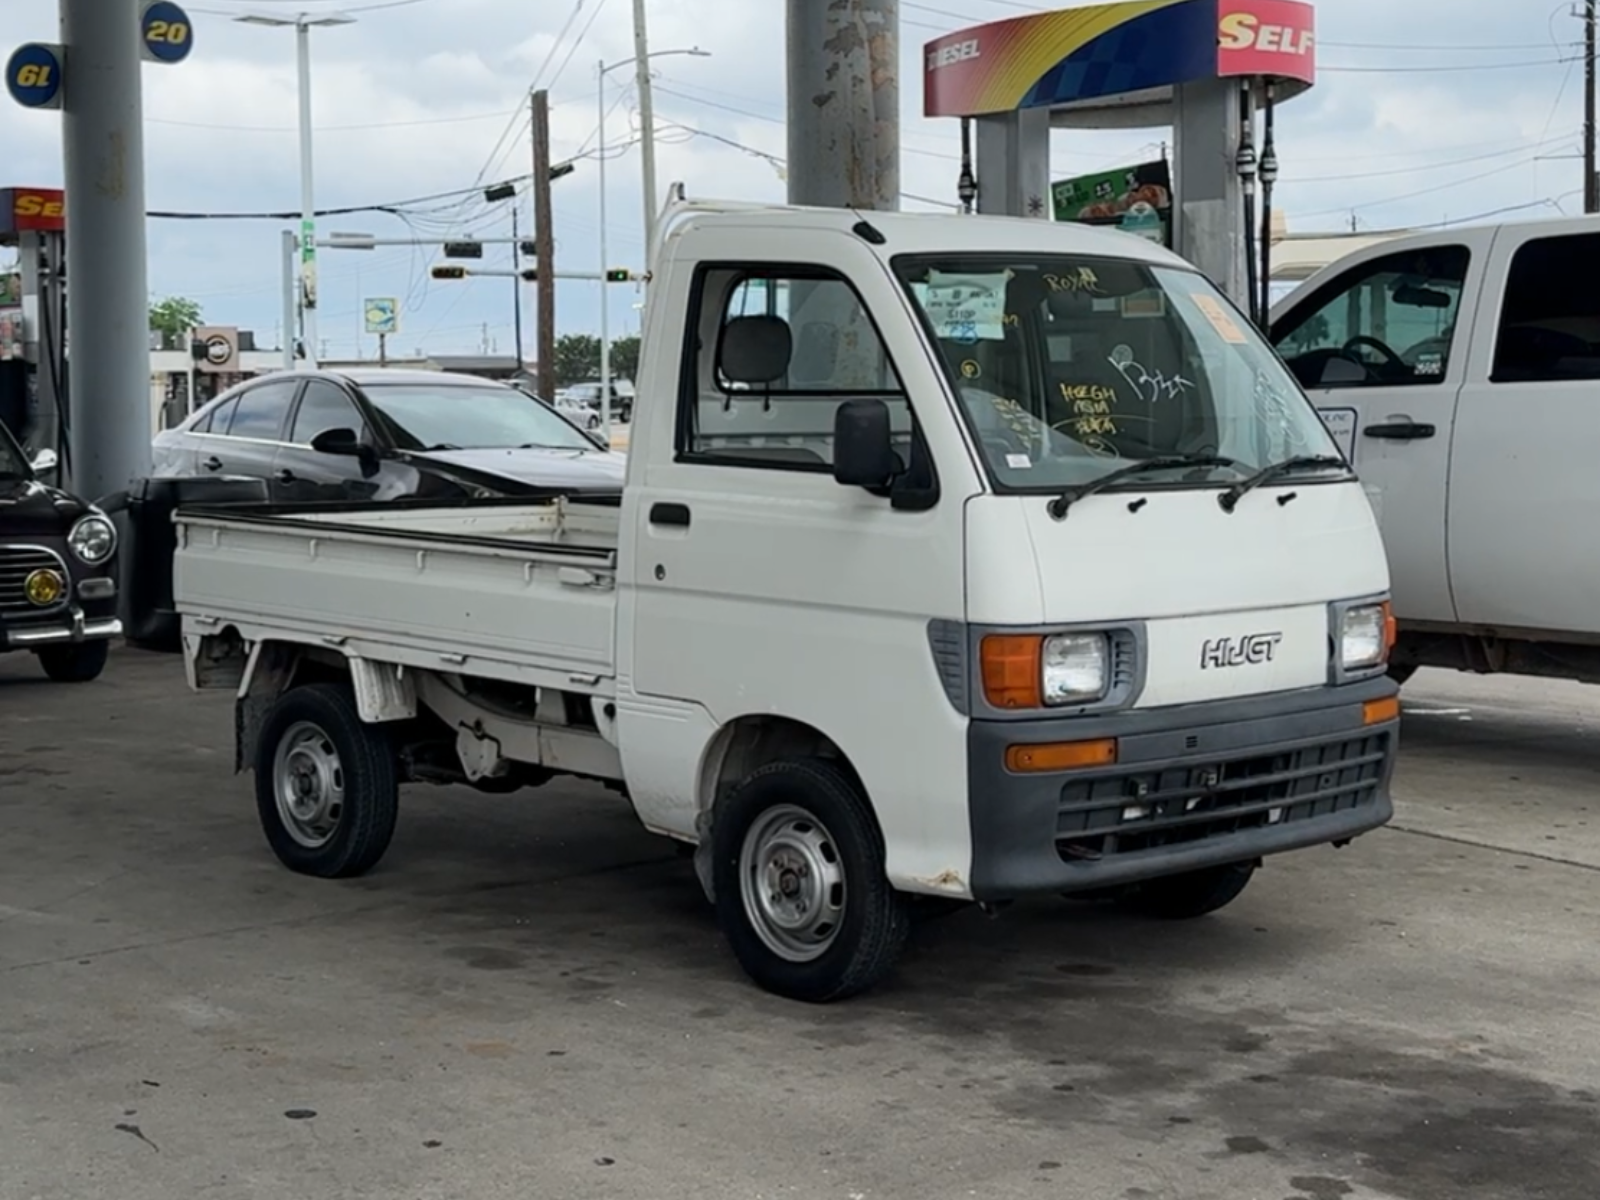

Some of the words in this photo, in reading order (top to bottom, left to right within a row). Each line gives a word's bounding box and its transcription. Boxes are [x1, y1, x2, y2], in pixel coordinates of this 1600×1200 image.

[147, 20, 188, 44] 20
[1218, 12, 1313, 55] SELF
[927, 38, 980, 71] DIESEL
[14, 195, 64, 216] SE
